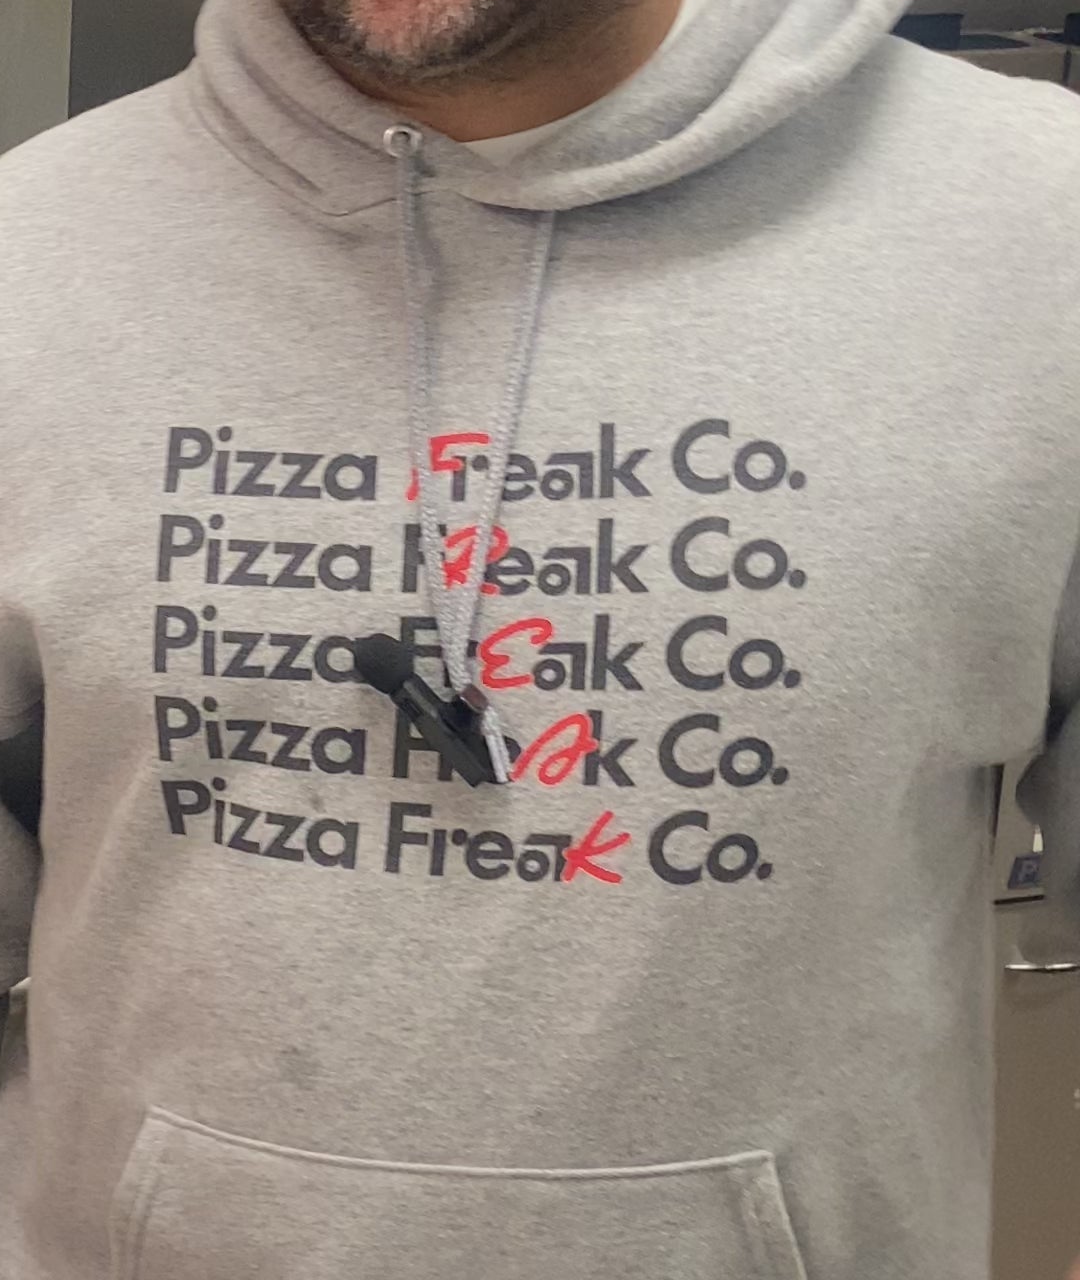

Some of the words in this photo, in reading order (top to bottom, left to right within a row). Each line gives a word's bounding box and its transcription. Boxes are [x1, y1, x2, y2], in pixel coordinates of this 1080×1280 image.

[164, 426, 377, 501] Pizza
[673, 418, 806, 495] Co.
[157, 514, 372, 591] Pizza
[671, 516, 806, 593] Co.
[154, 605, 365, 683] Pizza
[667, 615, 801, 690] Co.
[155, 695, 366, 775] Pizza
[659, 713, 789, 789] Co.
[161, 777, 359, 869] Pizza
[649, 810, 773, 885] Co.
